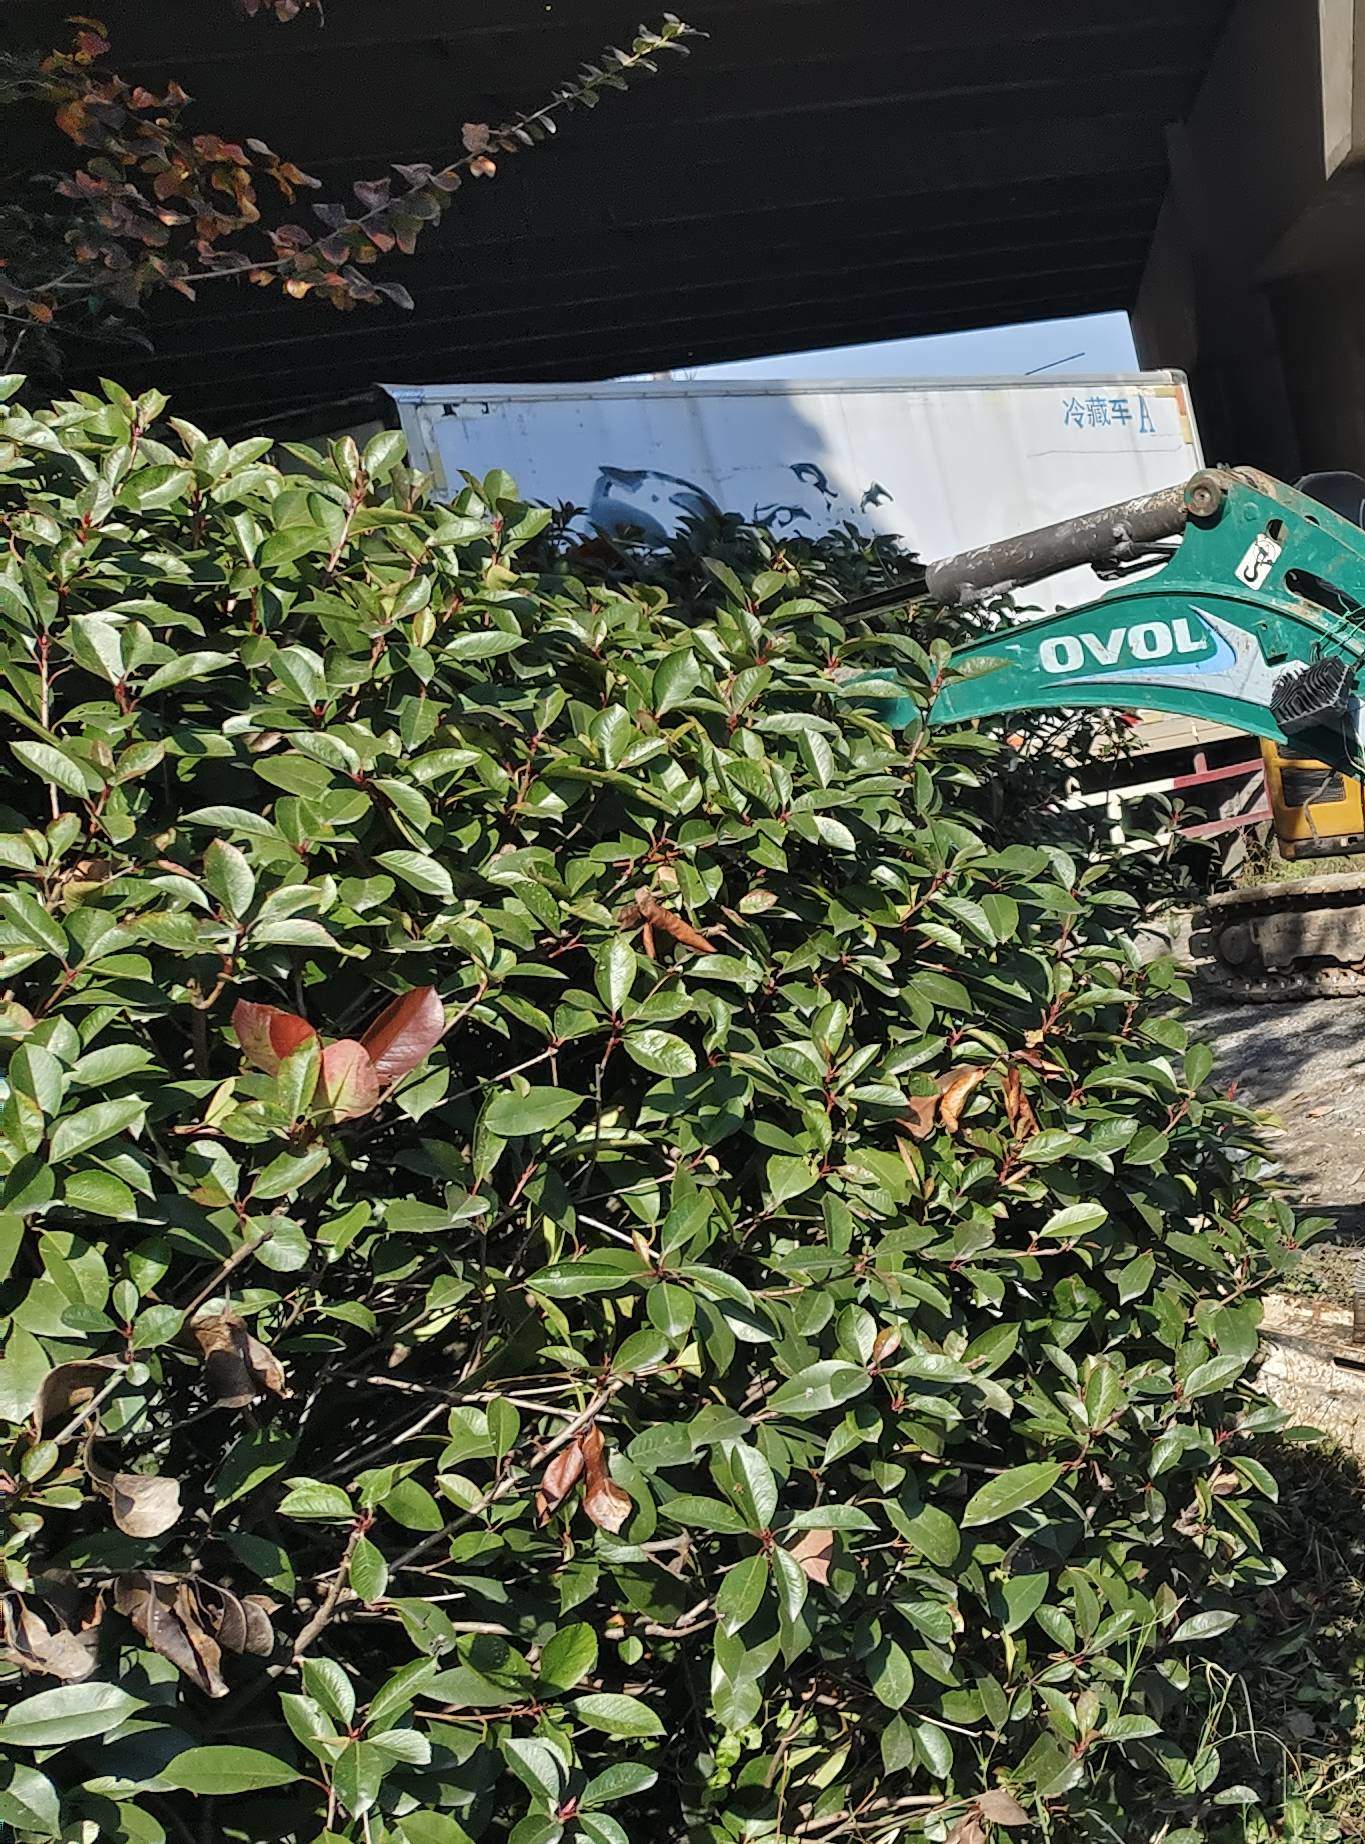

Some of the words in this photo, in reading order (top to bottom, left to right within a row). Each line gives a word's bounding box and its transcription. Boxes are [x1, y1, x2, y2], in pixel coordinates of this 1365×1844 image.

[1062, 396, 1132, 428] 冷藏车
[1138, 392, 1156, 433] A
[1039, 618, 1208, 674] OVOL
